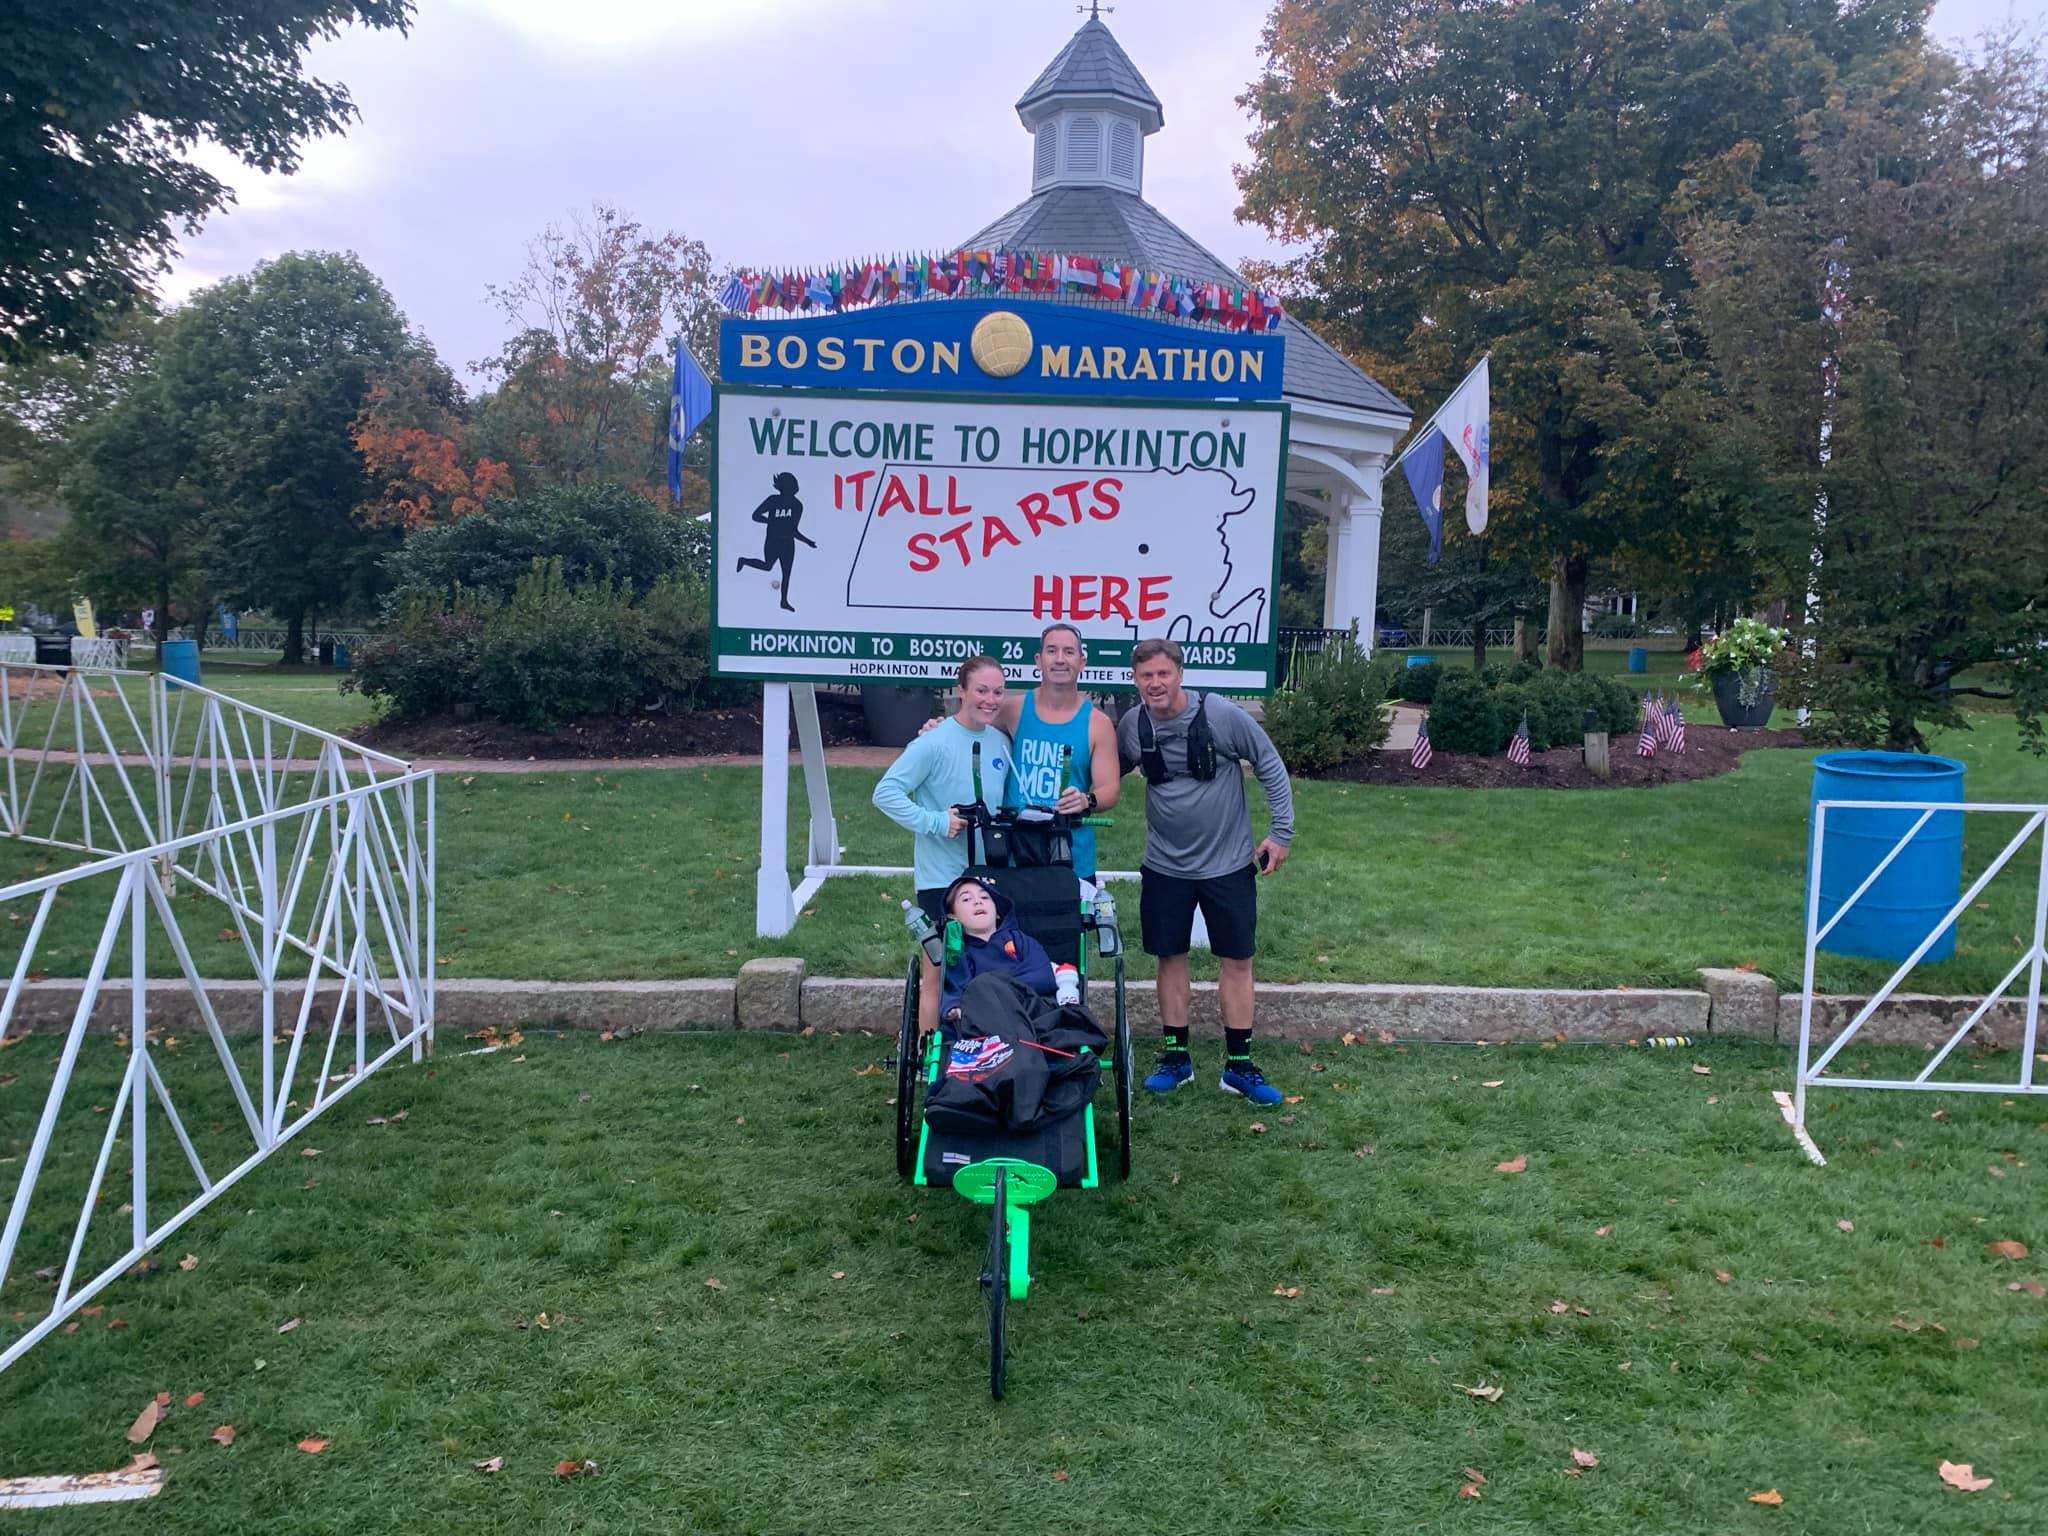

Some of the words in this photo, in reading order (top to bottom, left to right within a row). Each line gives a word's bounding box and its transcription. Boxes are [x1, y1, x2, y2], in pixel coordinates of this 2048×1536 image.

[740, 334, 960, 375] BOSTON
[1040, 344, 1264, 383] MARATHON
[748, 417, 934, 461] WELCOME
[955, 425, 999, 462] TO
[1022, 427, 1246, 468] HOPKINTON
[775, 508, 792, 518] BAA
[834, 470, 876, 512] IT
[877, 473, 973, 517] ALL
[907, 477, 1123, 572] STARTS
[1032, 575, 1173, 621] HERE
[750, 633, 856, 655] HOPKINTON
[872, 637, 894, 656] TO
[909, 638, 984, 658] BOSTON:
[1002, 641, 1024, 660] 26
[1180, 646, 1237, 665] YARDS
[850, 663, 929, 676] HOPKINTON
[1032, 668, 1113, 681] CITTEE
[1021, 738, 1059, 768] RUN
